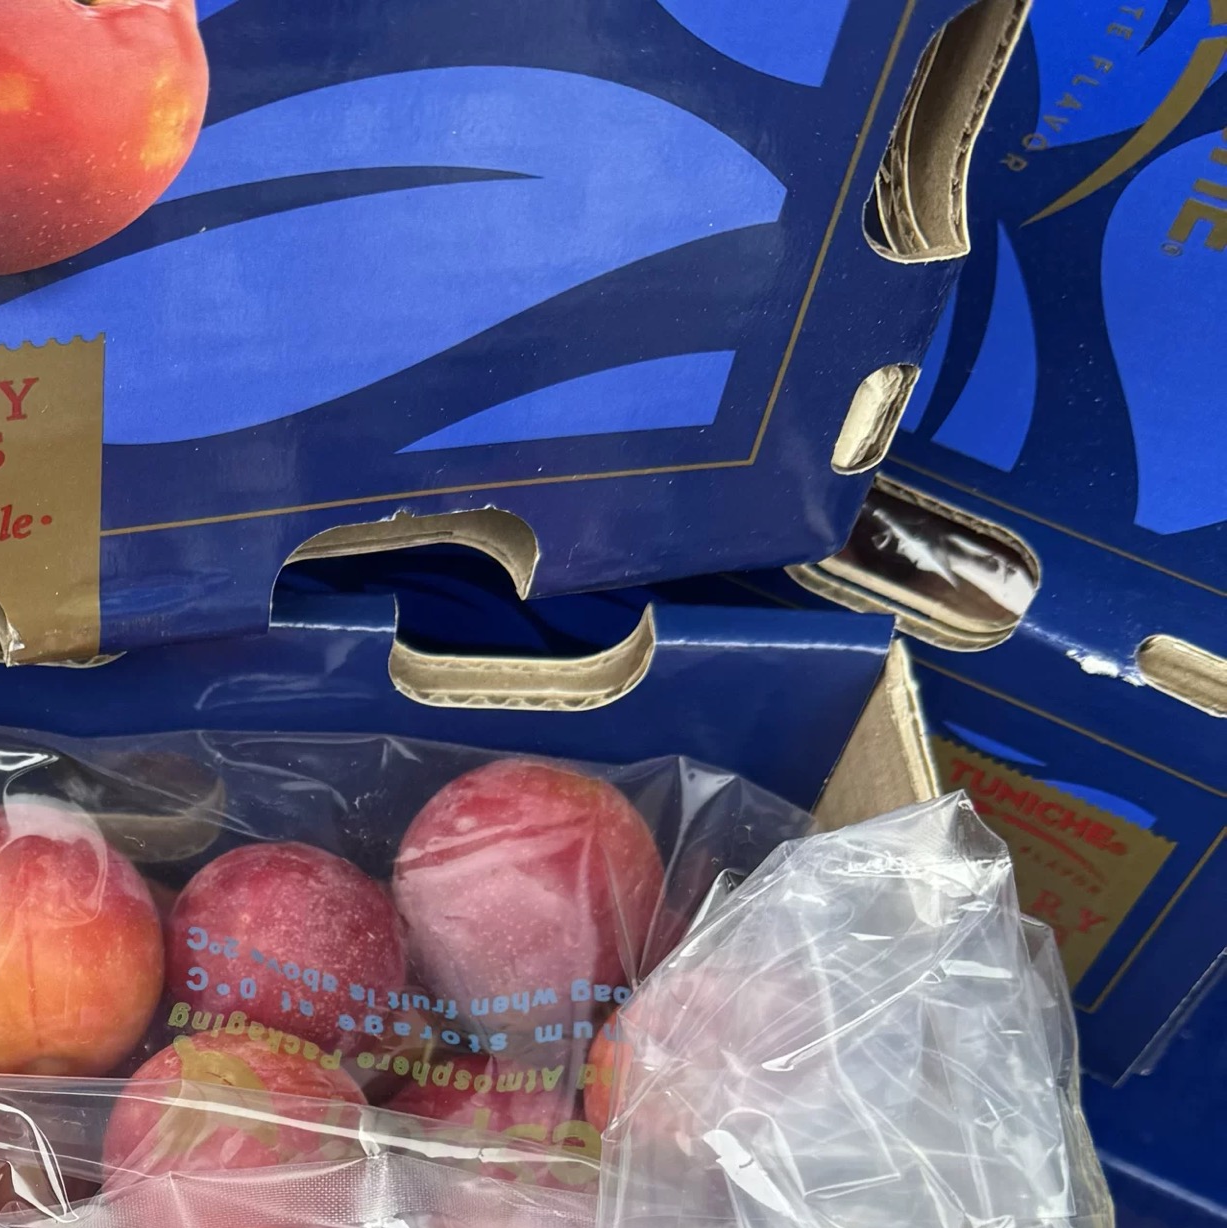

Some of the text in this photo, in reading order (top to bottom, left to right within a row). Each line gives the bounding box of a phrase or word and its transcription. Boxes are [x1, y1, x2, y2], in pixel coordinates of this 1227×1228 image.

[1000, 54, 1114, 172] FLAVOR
[252, 947, 338, 994] above
[280, 990, 315, 1016] at
[348, 983, 378, 1009] is
[387, 990, 458, 1020] fruit
[471, 986, 559, 1019] when
[167, 1001, 342, 1070] Packaging
[337, 1010, 509, 1052] storage
[356, 1049, 562, 1095] Atmosphere
